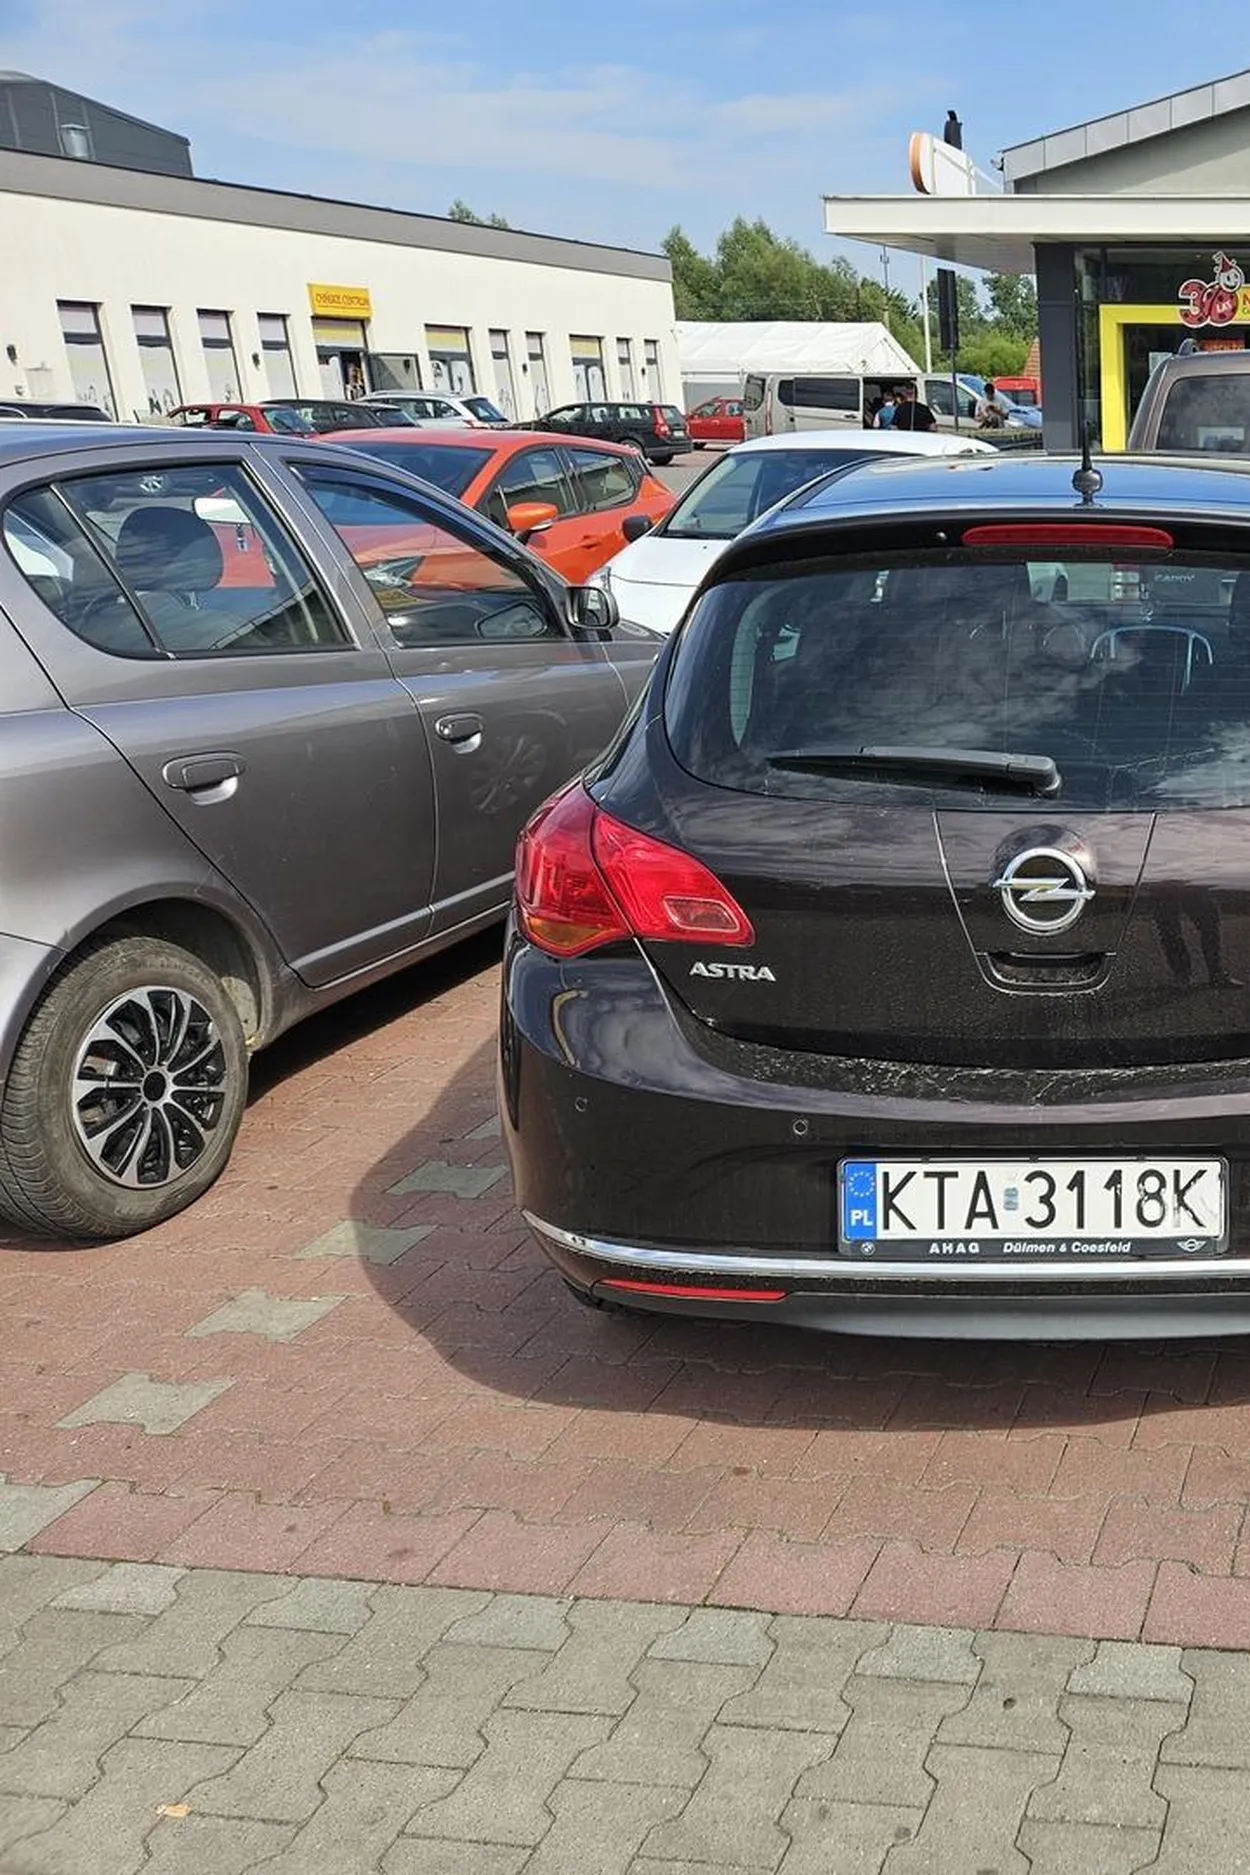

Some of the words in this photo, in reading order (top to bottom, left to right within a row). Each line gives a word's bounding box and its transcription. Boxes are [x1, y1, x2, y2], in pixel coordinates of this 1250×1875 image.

[689, 961, 776, 982] ASTRA
[882, 1170, 999, 1231] KTA
[1024, 1168, 1208, 1229] 3118K
[850, 1208, 873, 1227] PL
[929, 1242, 980, 1254] AHAG
[1003, 1241, 1055, 1253] Dülmen
[1072, 1241, 1132, 1253] Coesfeld
